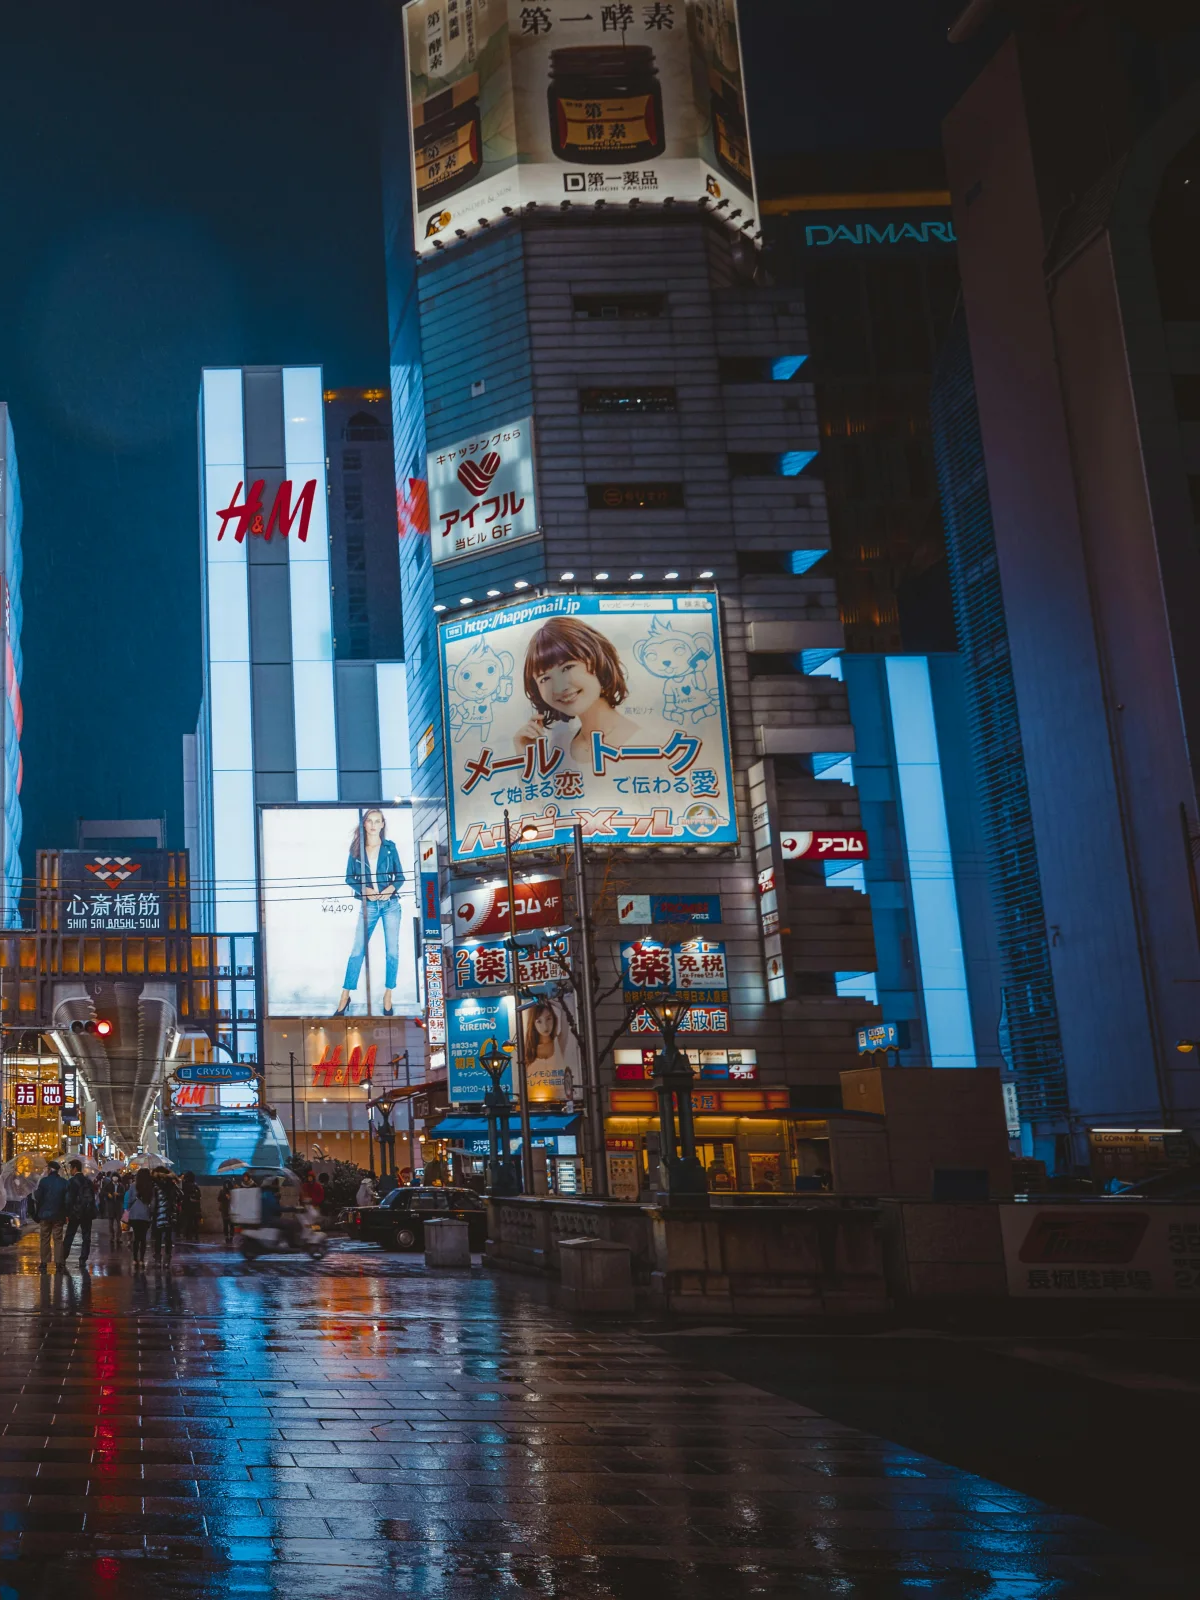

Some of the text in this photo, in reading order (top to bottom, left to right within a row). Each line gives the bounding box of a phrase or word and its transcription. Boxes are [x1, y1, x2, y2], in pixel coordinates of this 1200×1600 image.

[519, 2, 675, 35] 第一酵素
[427, 10, 444, 72] 第一酵素
[585, 103, 625, 118] 第一
[586, 123, 627, 140] 酵素
[588, 171, 658, 188] 第一薬品
[437, 429, 521, 465] キャッシングなら
[216, 478, 317, 543] H&M
[440, 491, 525, 537] アイフル
[455, 523, 513, 551] 当ビル 6F
[464, 598, 581, 635] http://happymail.jp
[624, 706, 655, 716] 高松リナ
[591, 729, 704, 777] トーク
[460, 736, 566, 795] メール
[490, 769, 586, 806] で始まる恋
[612, 767, 721, 799] で伝わる愛
[817, 838, 864, 853] アコム
[761, 883, 774, 893] アコム
[66, 892, 160, 917] 心斎橋筋
[321, 904, 354, 914] ¥4,499
[497, 896, 560, 918] アコム 4F
[67, 918, 88, 929] SHIN
[680, 941, 720, 953] 2F
[475, 949, 507, 984] 薬
[631, 947, 673, 987] 薬
[677, 954, 724, 972] 免税
[459, 1022, 497, 1032] KIREIMO
[888, 1027, 896, 1042] P
[196, 1068, 232, 1076] CRYSTA
[312, 1044, 378, 1088] H&M
[42, 1095, 62, 1105] QLO
[43, 1086, 60, 1095] UNI
